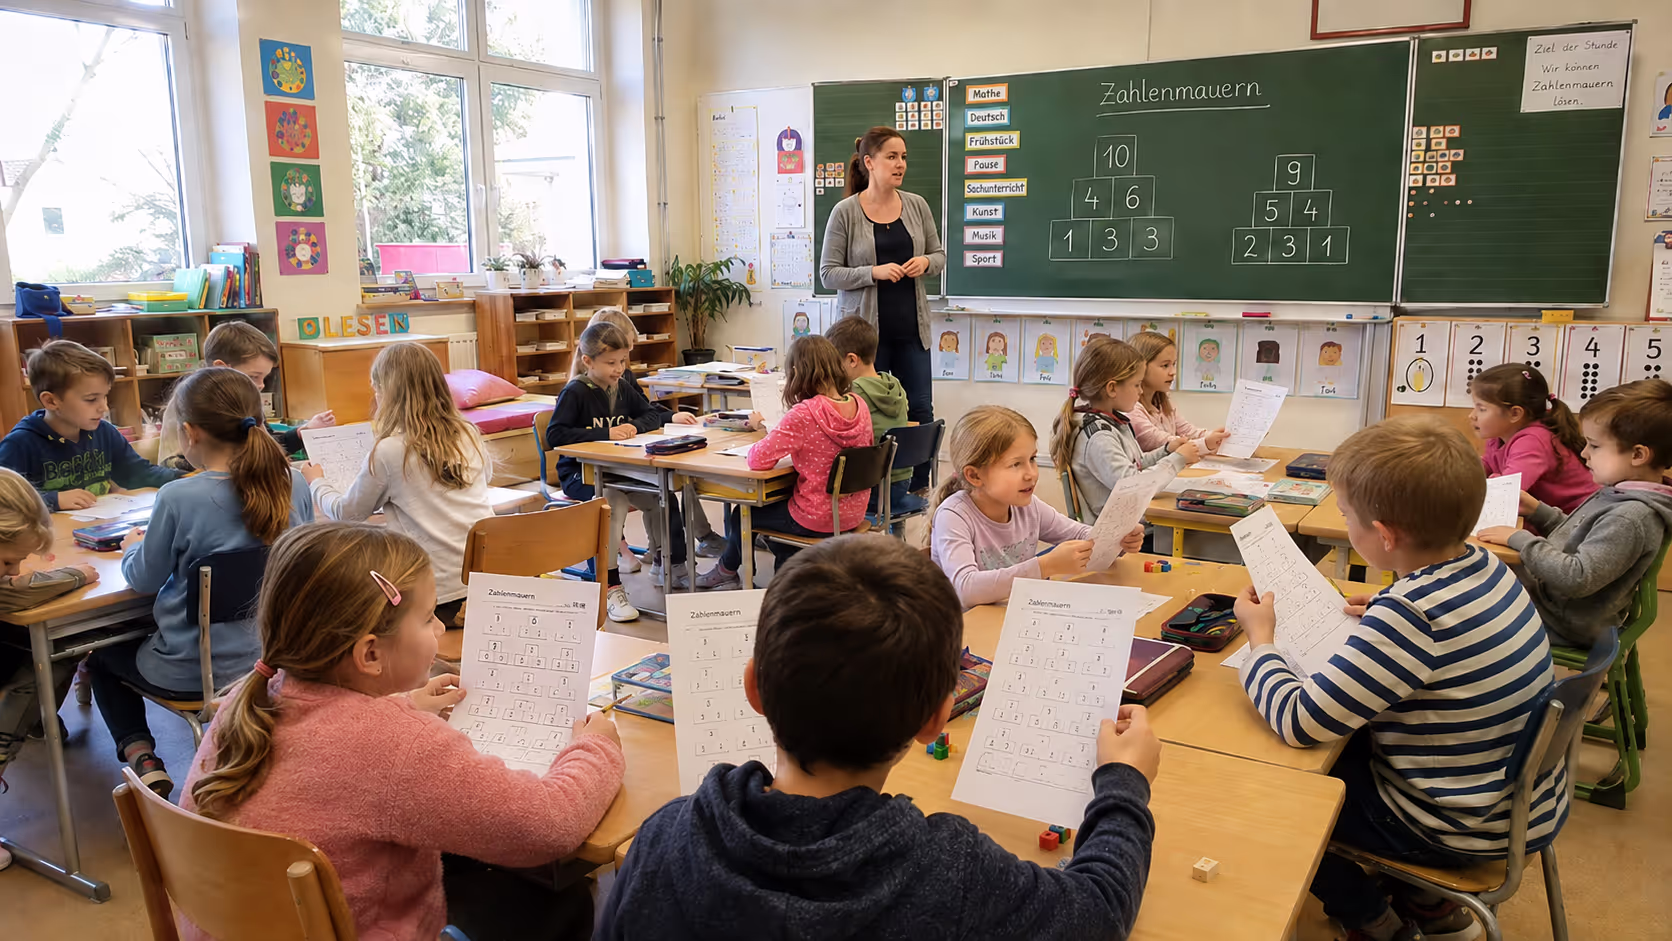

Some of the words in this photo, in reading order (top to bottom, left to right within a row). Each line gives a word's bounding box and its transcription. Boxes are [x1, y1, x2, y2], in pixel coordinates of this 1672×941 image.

[1534, 42, 1556, 54] Ziel
[1562, 43, 1579, 52] der
[1584, 40, 1618, 50] Stunde
[1541, 64, 1560, 73] Wir
[1565, 62, 1600, 72] können
[1099, 79, 1262, 105] Zahlenmauern
[1532, 80, 1614, 92] Zahlenmauern
[973, 89, 1001, 99] Mathe
[1553, 96, 1583, 106] lösen.
[970, 111, 1005, 122] Deutsch
[969, 135, 1014, 146] Frühstück
[1103, 144, 1129, 168] 10
[974, 160, 999, 170] Pause
[1287, 160, 1301, 185] 9
[967, 183, 1025, 193] Sachunterricht
[1084, 187, 1099, 210] 4
[1125, 185, 1140, 209] 6
[972, 207, 998, 216] Kunst
[1264, 199, 1279, 222] 5
[1303, 199, 1318, 221] 4
[972, 231, 997, 240] Musik
[1063, 228, 1073, 252] 1
[1102, 227, 1118, 251] 3
[1143, 226, 1159, 251] 3
[1243, 235, 1258, 257] 2
[1282, 235, 1296, 257] 3
[1321, 235, 1332, 257] 1
[972, 254, 997, 265] Sport
[1415, 334, 1427, 353] 1
[1469, 334, 1484, 355] 2
[1526, 335, 1541, 356] 3
[1584, 336, 1600, 358] 4
[1646, 338, 1662, 359] 5
[592, 415, 625, 428] NYC
